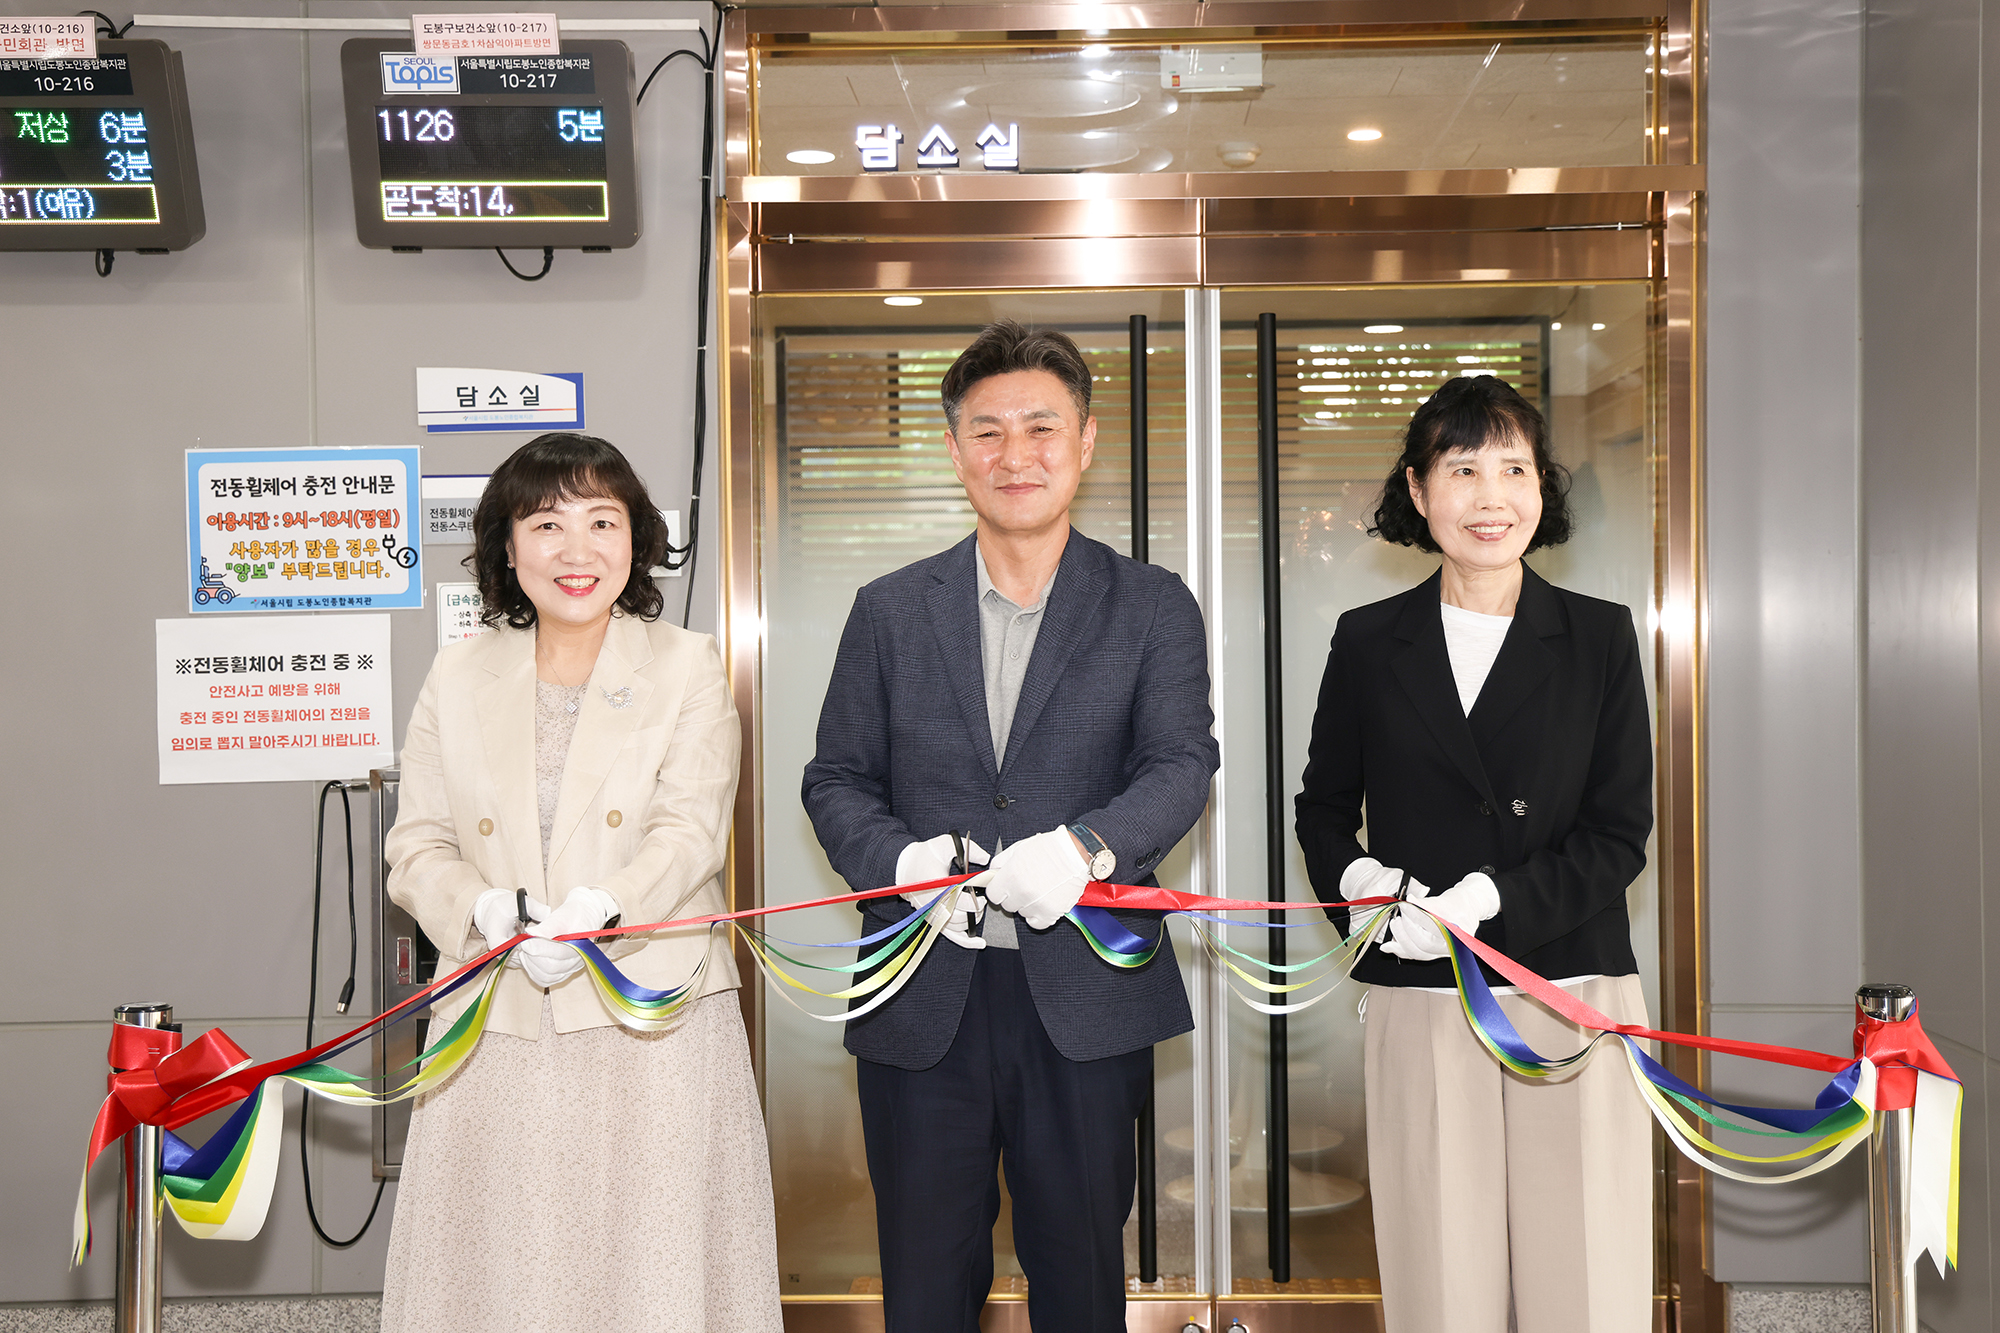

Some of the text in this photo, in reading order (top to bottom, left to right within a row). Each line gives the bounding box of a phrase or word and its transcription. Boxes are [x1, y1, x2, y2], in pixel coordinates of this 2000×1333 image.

[423, 23, 547, 34] 도봉구보건소앞(10-217)
[0, 38, 47, 52] 민회관
[0, 59, 127, 70] 울특별시립도봉노인종합복지관
[403, 57, 436, 65] SEOUL
[460, 58, 591, 70] 서울특별시립도봉노인종합복지관
[34, 76, 94, 91] 10-216
[499, 73, 557, 88] 10-217
[14, 111, 147, 144] 저상 6분
[378, 109, 604, 142] 1126 5분
[856, 123, 1020, 171] 담소실
[105, 150, 152, 182] 3분
[456, 384, 540, 408] 담소실
[210, 474, 396, 498] 전동휠체어 충전 안내문
[206, 511, 270, 531] 이용시간
[282, 508, 400, 530] 9시~18시(평일)
[229, 538, 380, 560] 사용자가 많을 경우
[225, 560, 390, 582] "양보" 부탁드립니다.
[260, 596, 372, 608] 서울시립 도봉노인종합복지관
[290, 654, 327, 672] 충전
[333, 653, 350, 671] 중
[209, 682, 341, 698] 안전사고 예방을 위해
[180, 707, 371, 725] 충전 중인 전동휠체어의 전원을
[171, 732, 380, 751] 임의로 뽑지 말아주시기 바랍니다.
